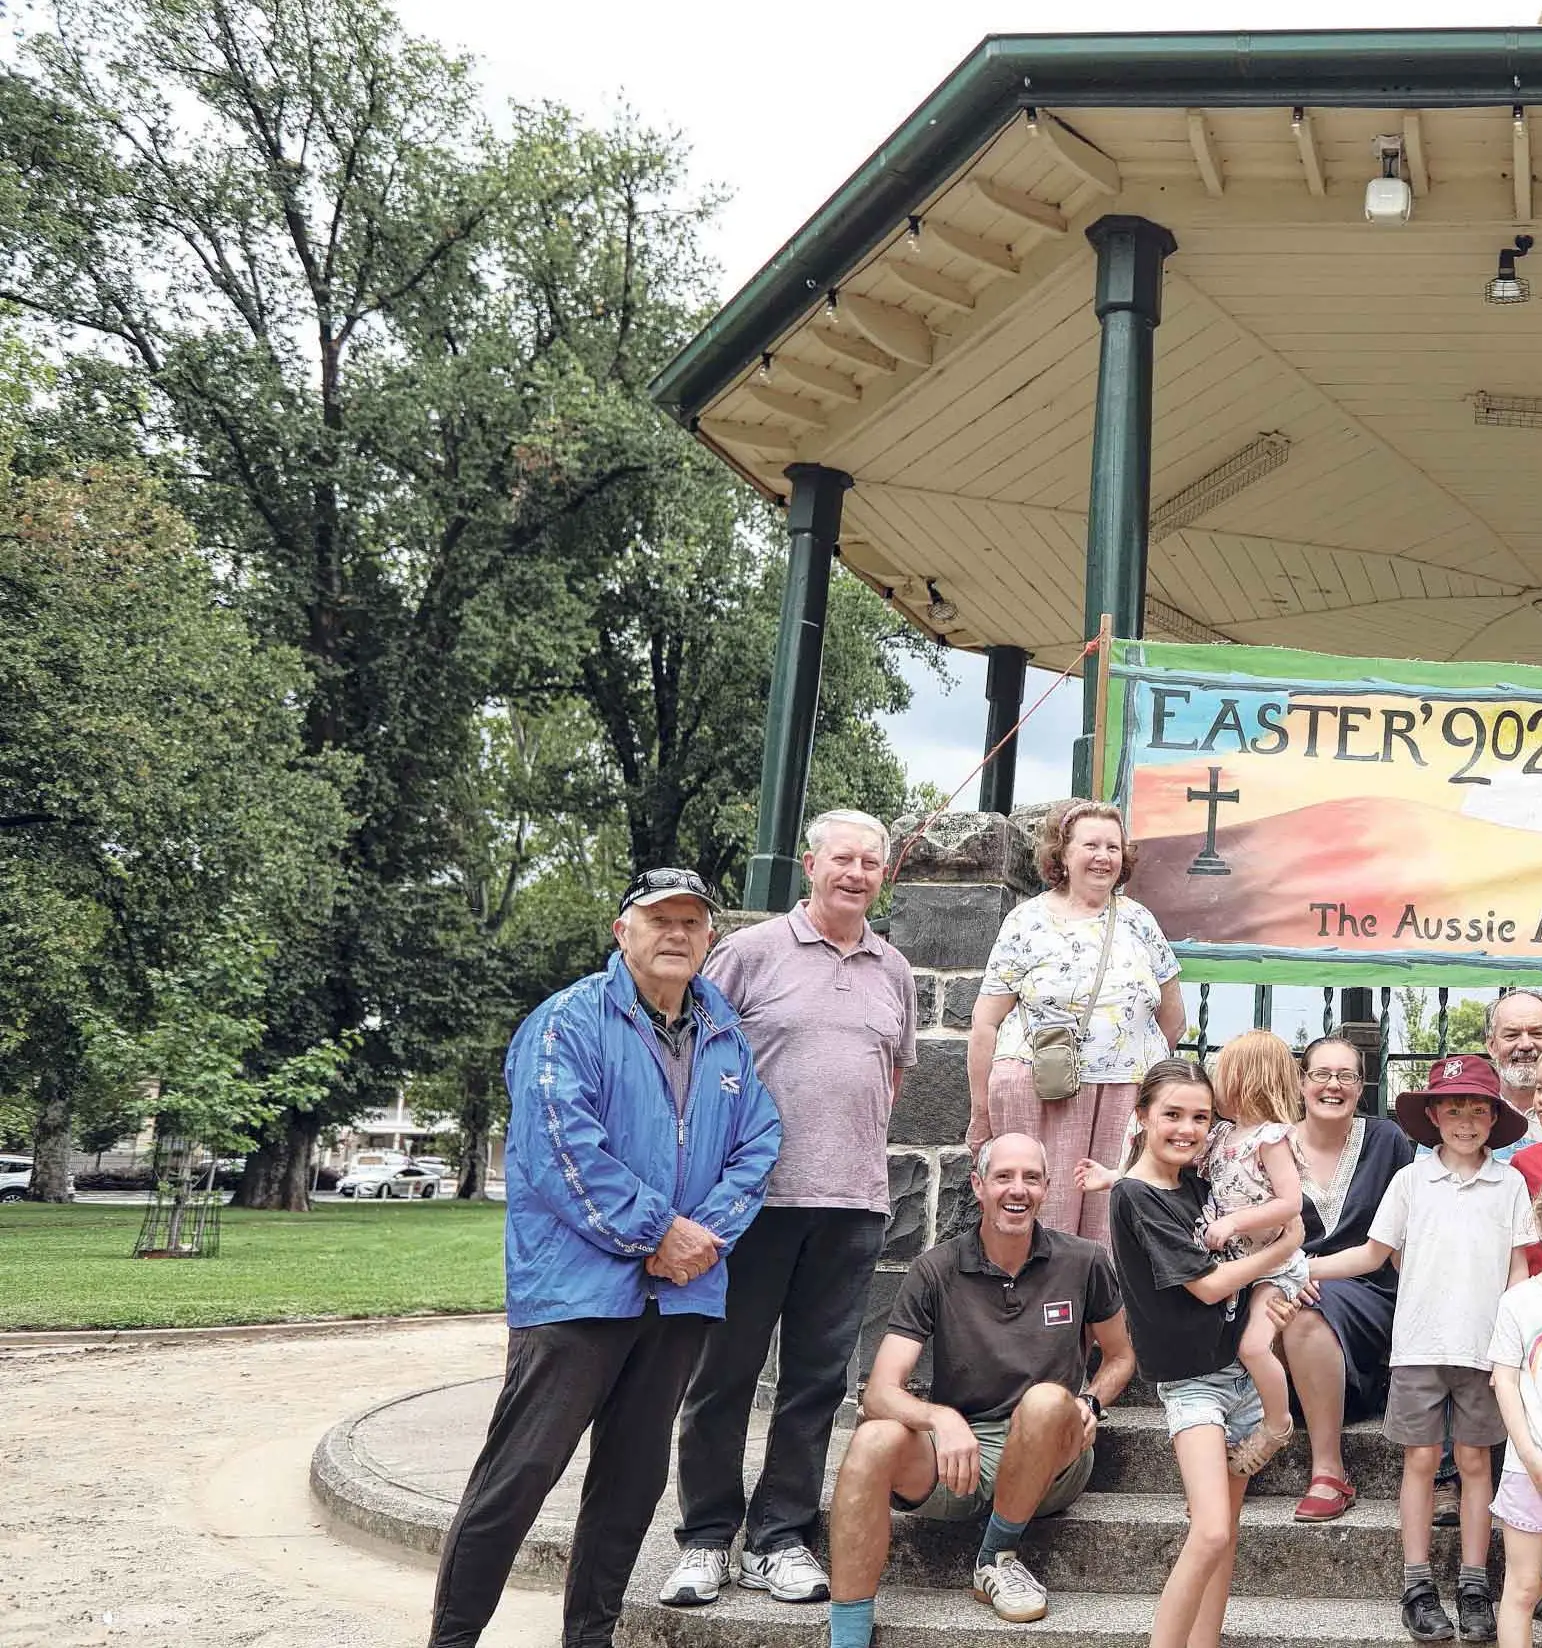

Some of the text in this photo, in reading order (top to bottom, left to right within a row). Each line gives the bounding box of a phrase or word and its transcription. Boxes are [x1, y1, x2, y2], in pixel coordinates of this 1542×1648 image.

[1309, 902, 1378, 938] The
[1392, 903, 1517, 943] Aussie
[757, 1555, 776, 1577] N
